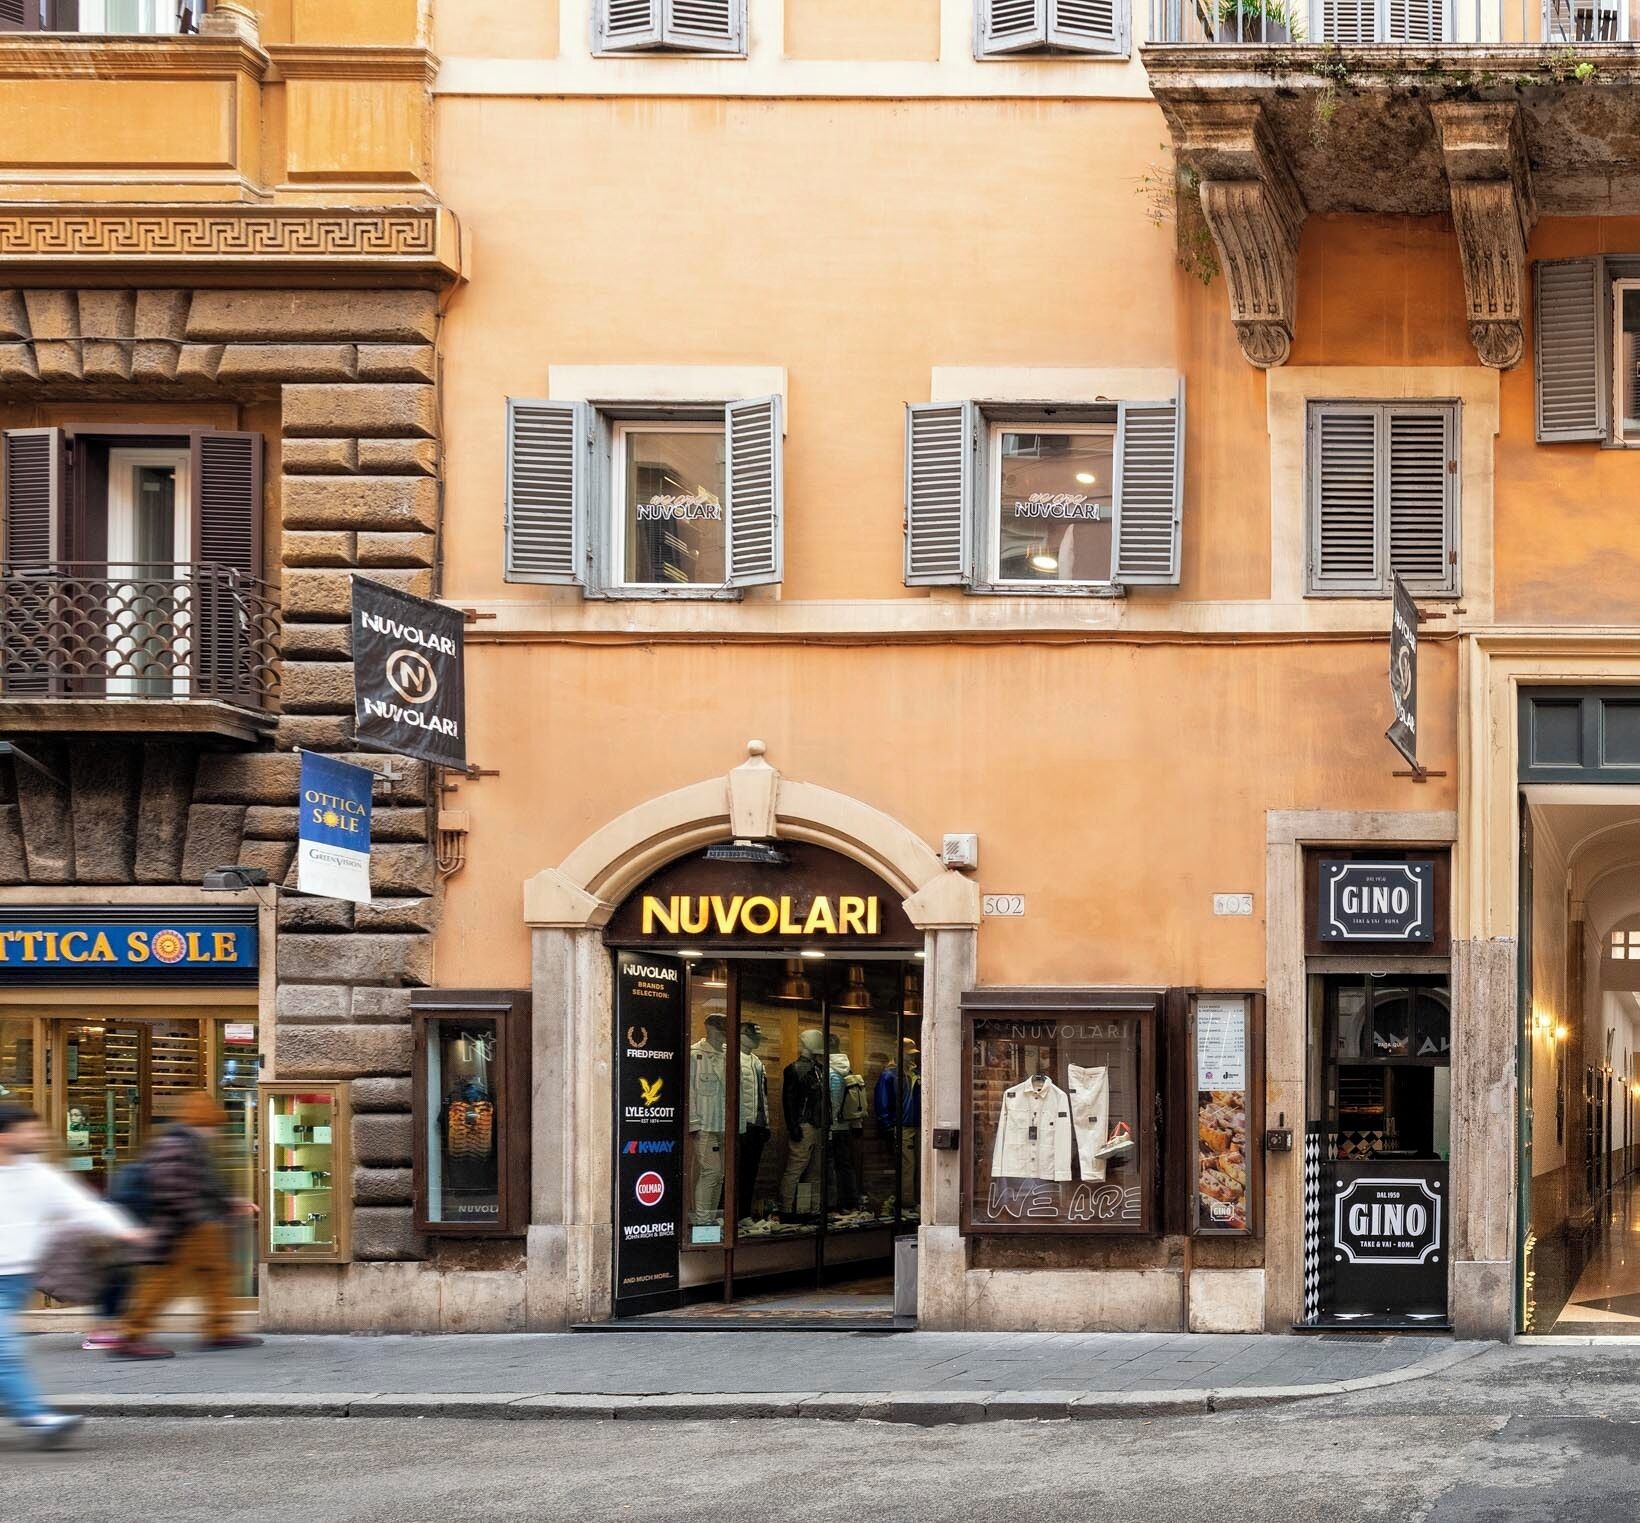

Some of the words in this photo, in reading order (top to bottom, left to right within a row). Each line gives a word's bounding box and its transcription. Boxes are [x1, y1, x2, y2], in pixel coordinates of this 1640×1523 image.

[637, 504, 721, 520] NUVOLARI
[1014, 502, 1100, 520] NUVOLARI
[361, 611, 457, 659] NUVOLARI
[364, 698, 459, 740] NUVOLARI
[304, 790, 366, 816] OTTICA
[984, 897, 1023, 914] 502
[1342, 886, 1410, 914] GINO
[642, 895, 878, 934] NUVOLARI
[623, 963, 678, 982] NUVOLARI
[632, 989, 670, 999] SELECTION:
[637, 981, 665, 990] BRANDS
[1011, 1024, 1128, 1039] NUVOLARI
[627, 1049, 648, 1058] FRED
[648, 1050, 674, 1060] PERRY
[638, 1183, 662, 1194] COLMAR
[987, 1181, 1061, 1218] WE
[1068, 1184, 1141, 1220] ARE
[623, 1222, 675, 1235] WOOLRICH
[1349, 1203, 1427, 1236] GINO
